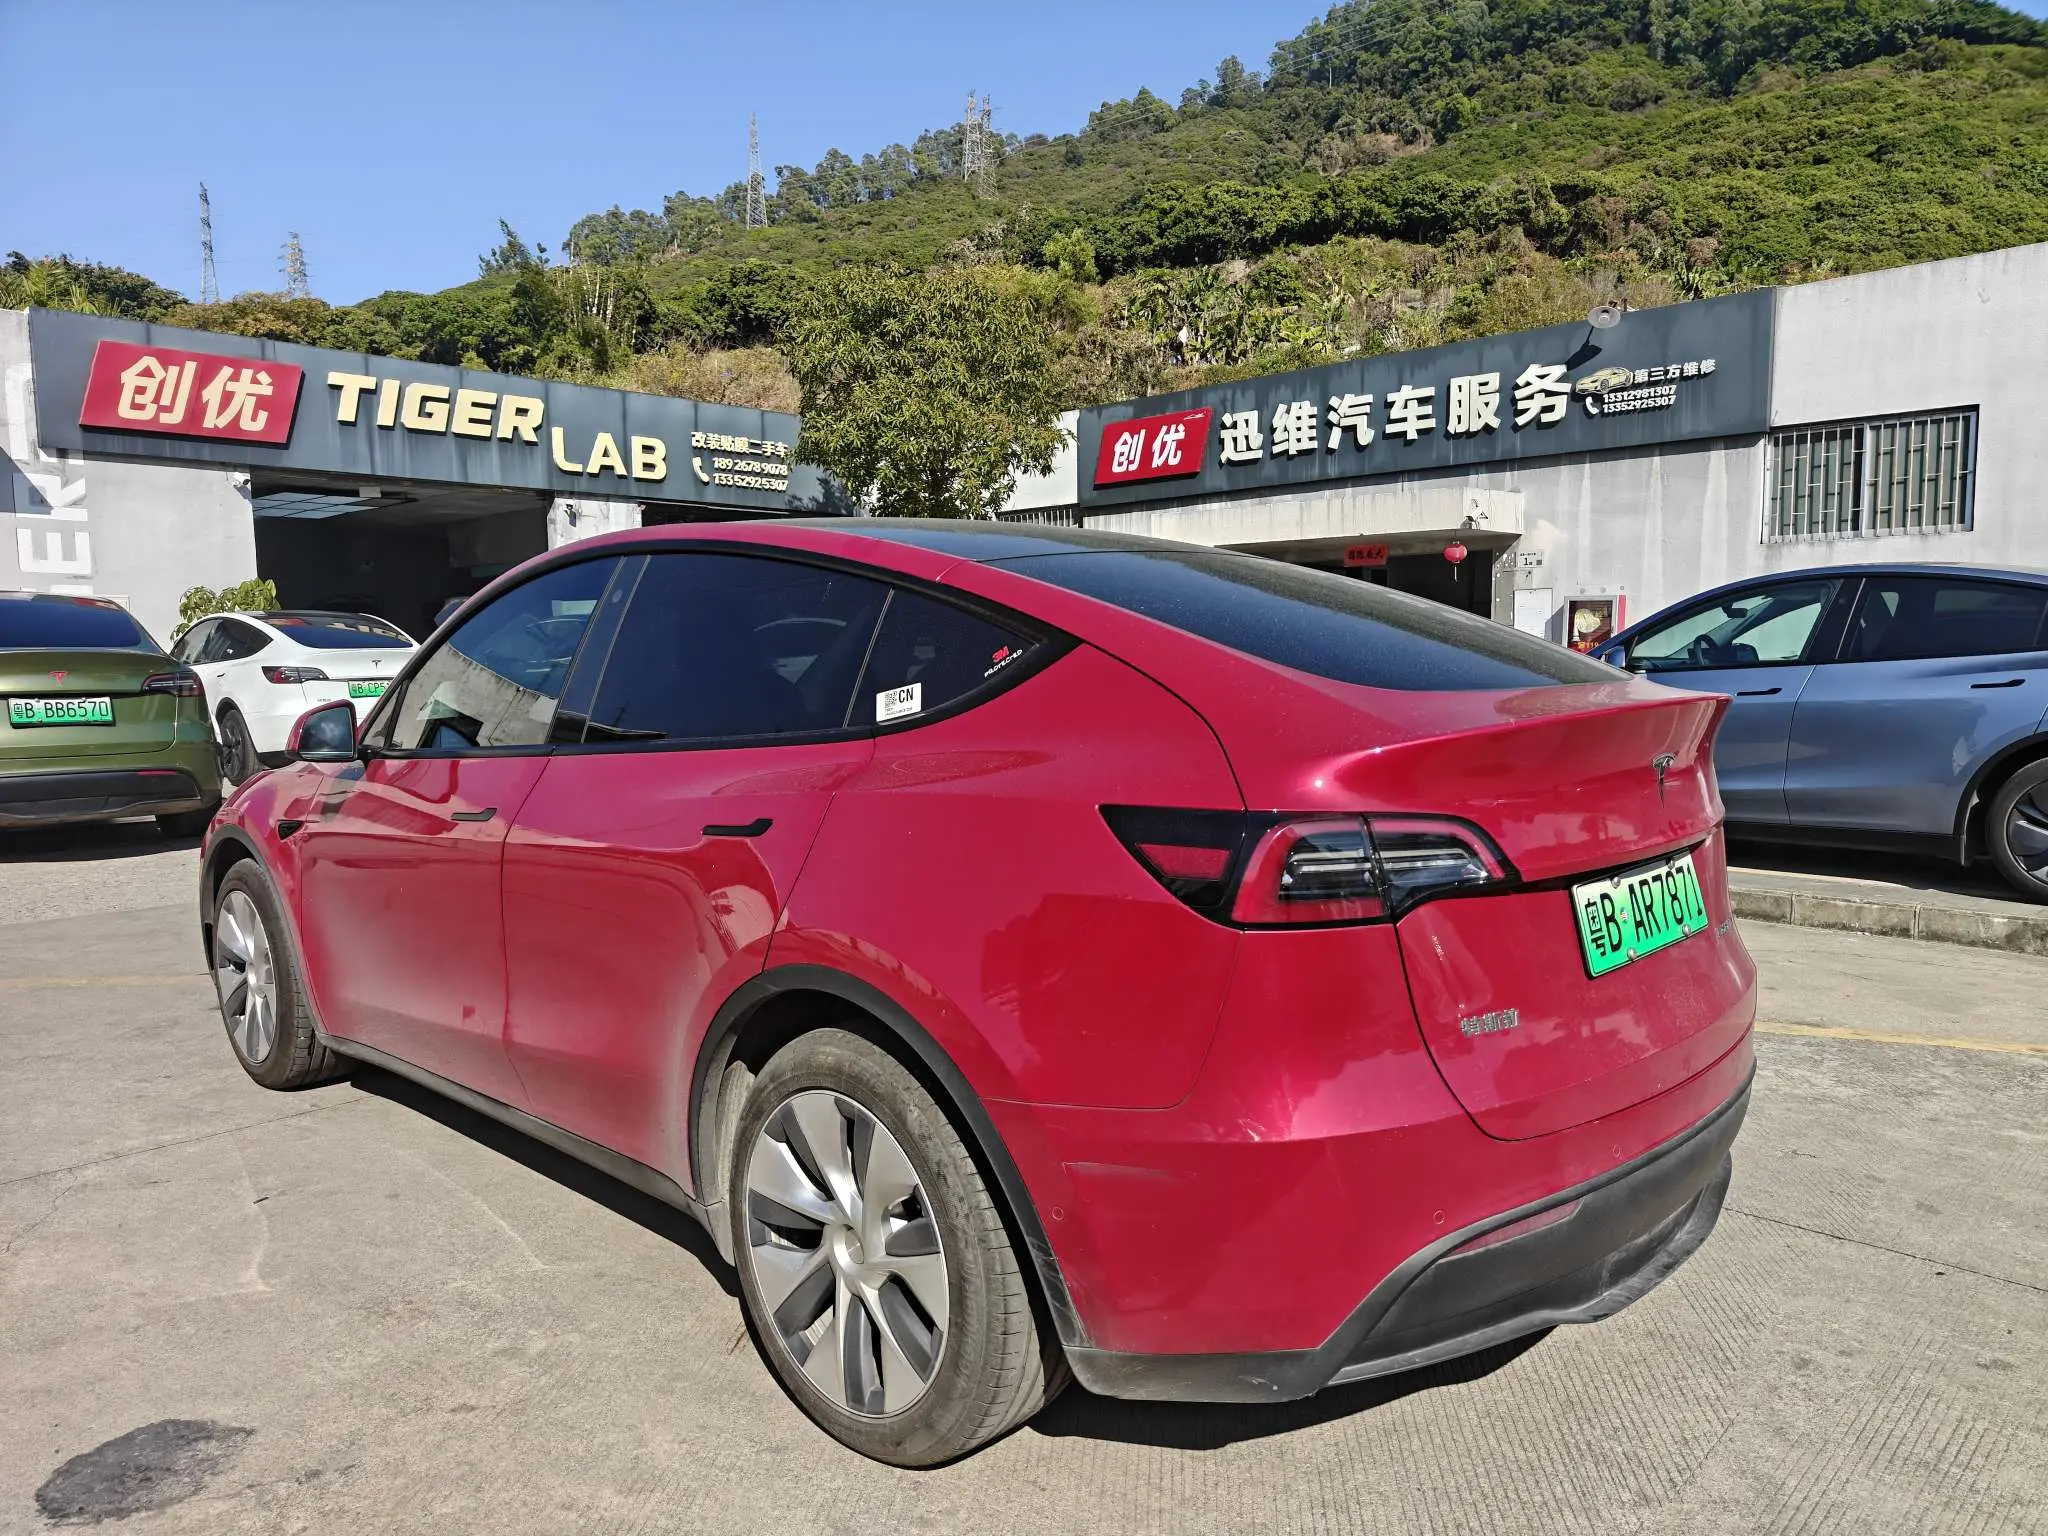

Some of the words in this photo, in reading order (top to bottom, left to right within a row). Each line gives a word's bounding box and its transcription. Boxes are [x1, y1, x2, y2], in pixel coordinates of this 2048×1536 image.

[1633, 358, 1718, 384] 第三方维修
[117, 355, 273, 431] 创优
[1602, 385, 1677, 403] 13312981307
[1602, 395, 1677, 413] 13352925307
[326, 371, 545, 443] TIGER
[551, 426, 667, 481] LAB
[1219, 363, 1572, 464] 迅维汽车服务
[691, 431, 789, 458] 改装贴膜二手车
[1111, 423, 1186, 473] 创优
[898, 687, 914, 704] CN
